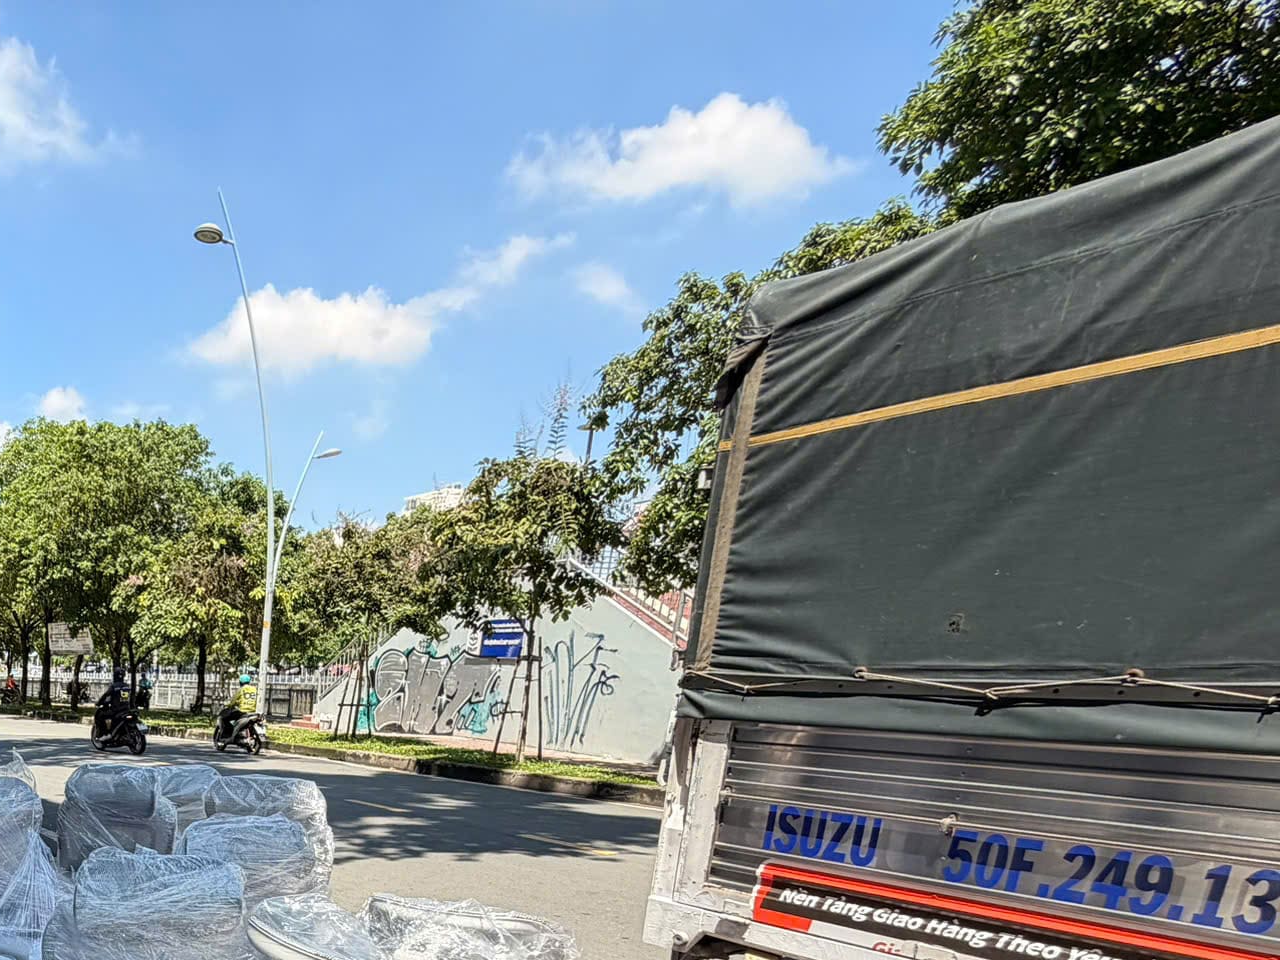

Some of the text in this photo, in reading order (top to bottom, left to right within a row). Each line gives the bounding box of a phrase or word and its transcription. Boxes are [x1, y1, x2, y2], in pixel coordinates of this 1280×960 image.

[762, 804, 884, 868] ISUZU
[943, 830, 1280, 935] 50F.249.13
[872, 908, 926, 930] Giao
[924, 918, 993, 948] Hàng
[996, 932, 1062, 959] Theo
